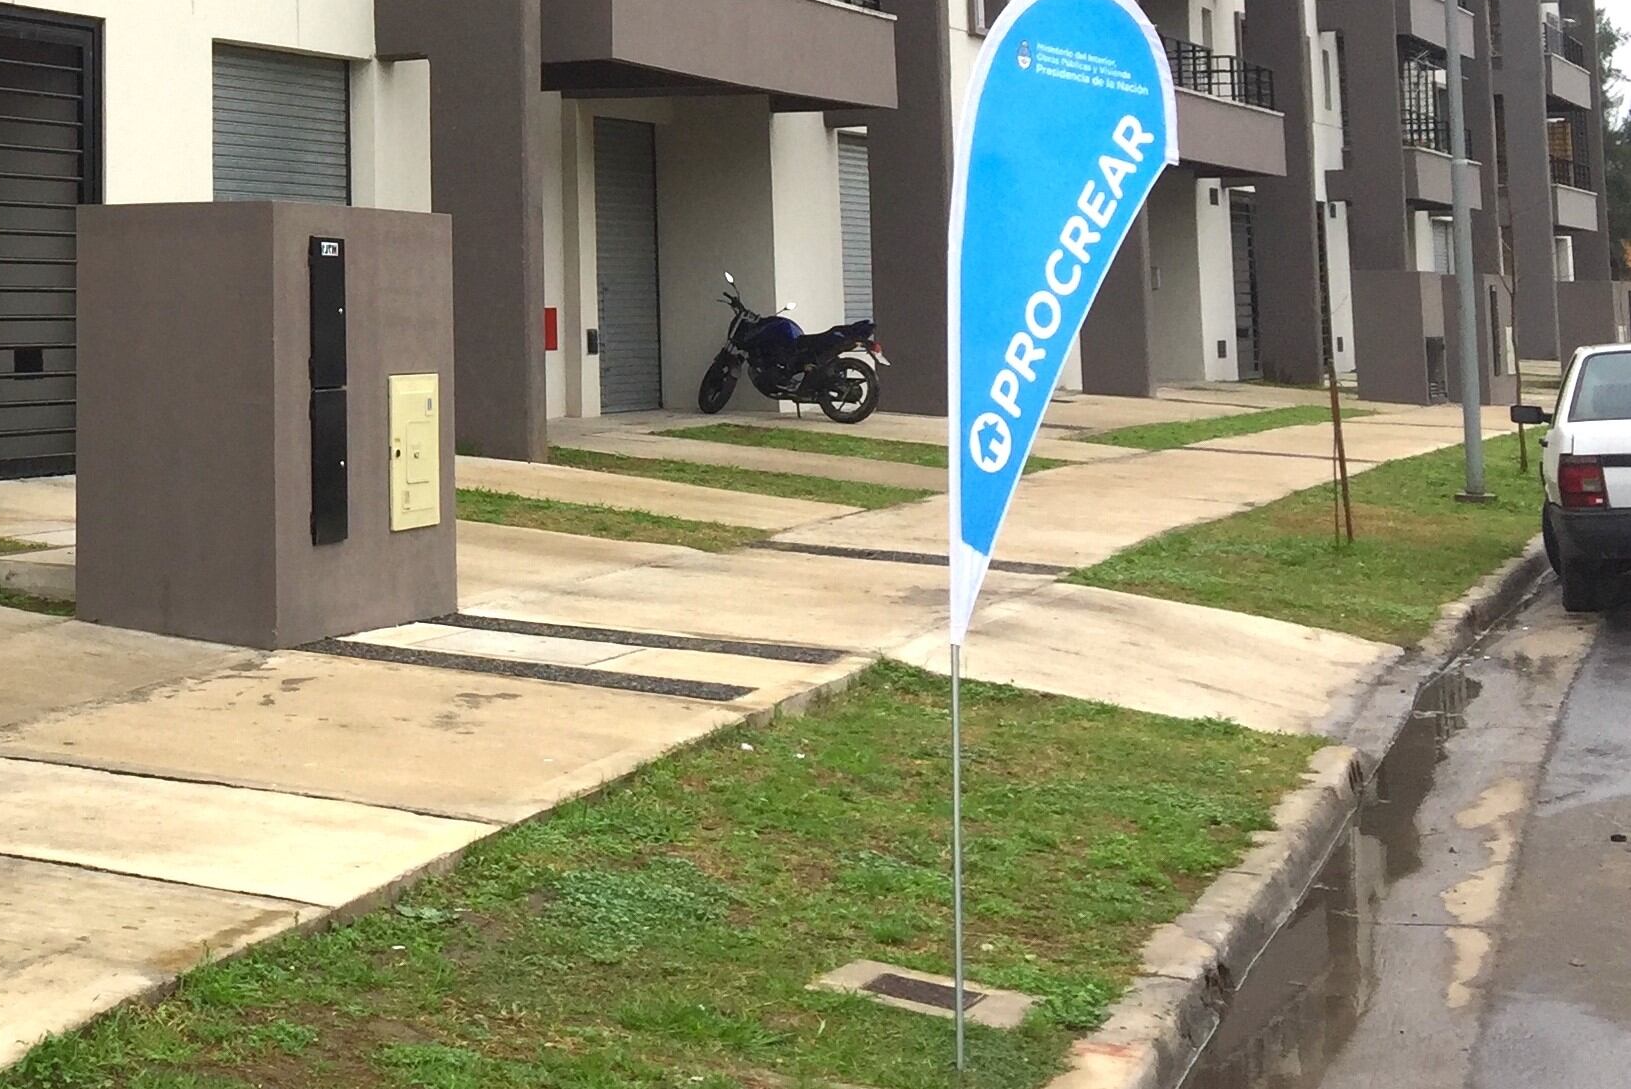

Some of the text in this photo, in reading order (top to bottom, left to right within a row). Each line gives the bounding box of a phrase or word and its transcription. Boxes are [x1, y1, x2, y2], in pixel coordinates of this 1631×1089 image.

[1036, 63, 1149, 96] Presidencia de la Nación
[990, 114, 1155, 418] PROCREAR
